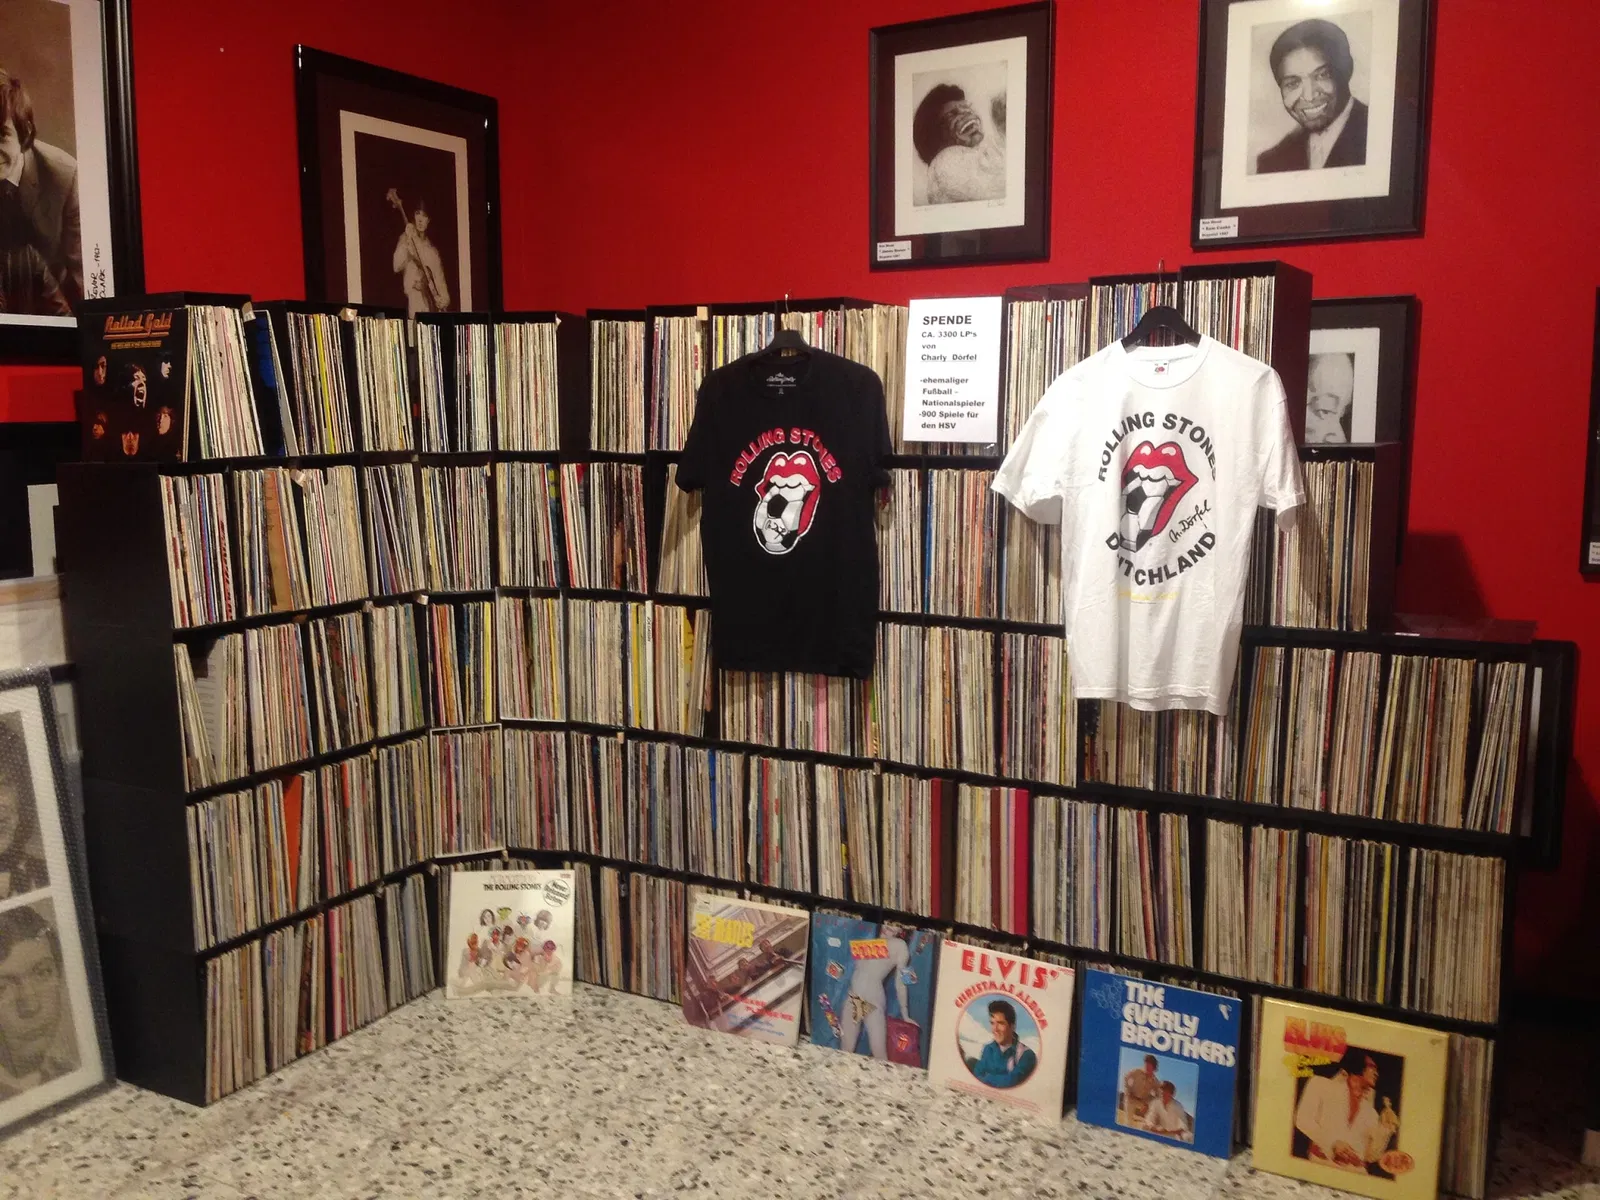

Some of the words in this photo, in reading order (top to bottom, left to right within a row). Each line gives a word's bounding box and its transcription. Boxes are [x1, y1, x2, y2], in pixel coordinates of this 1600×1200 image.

[922, 315, 972, 325] SPENDE
[921, 354, 947, 362] Charly
[952, 353, 977, 361] Dörfel
[920, 377, 969, 385] -ehemaliger
[922, 399, 985, 408] Nationalspieler
[919, 410, 936, 418] -900
[938, 411, 964, 419] Spiele
[729, 427, 786, 487] ROLLING
[483, 883, 494, 891] THE
[494, 883, 520, 891] ROLLING
[1124, 980, 1165, 1008] THE
[955, 980, 1015, 1008] CHRISTMAS
[1016, 990, 1048, 1030] ALBUM
[1122, 1002, 1200, 1037] EVERLY
[1120, 1020, 1236, 1068] BROTHERS
